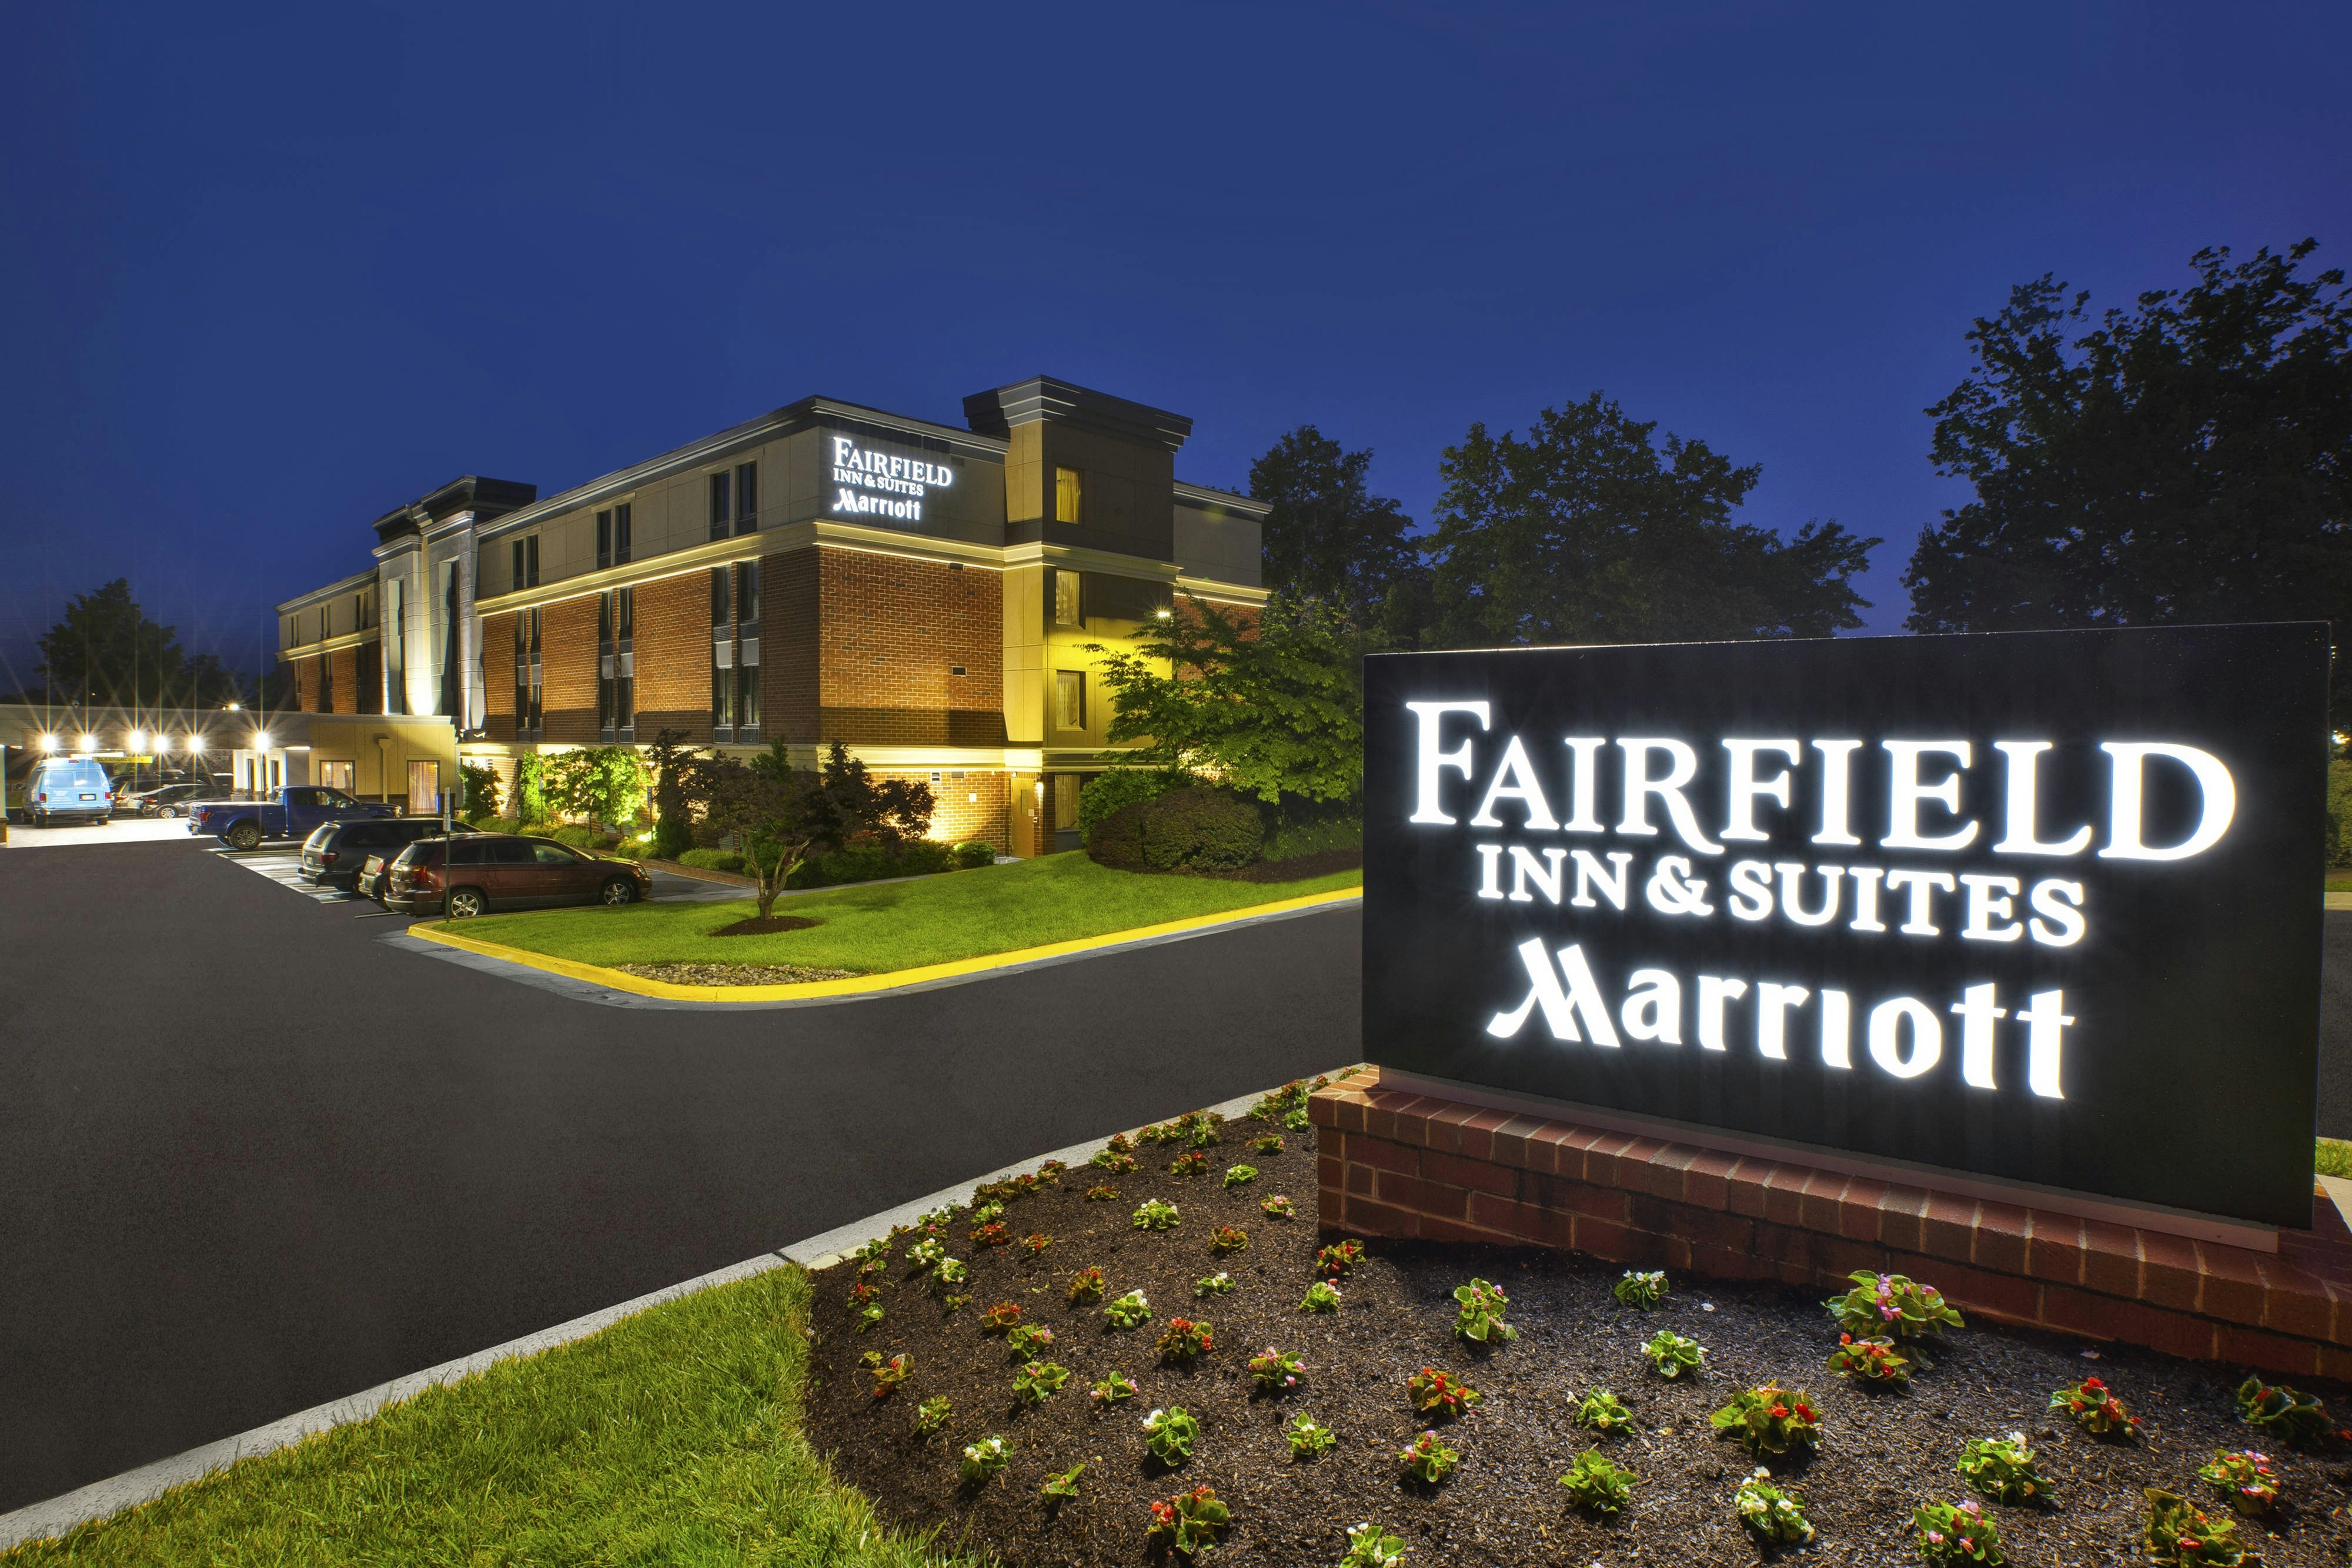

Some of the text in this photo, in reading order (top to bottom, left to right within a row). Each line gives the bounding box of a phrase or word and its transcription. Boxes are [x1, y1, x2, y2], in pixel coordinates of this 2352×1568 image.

[833, 436, 953, 487] FAIRFIELD
[833, 467, 924, 496] INN & SUITES
[833, 488, 921, 520] Marriott
[1405, 700, 2236, 861] FAIRFIELD
[1476, 844, 2086, 947] INN & SUITES
[1486, 937, 2076, 1099] Marriott
